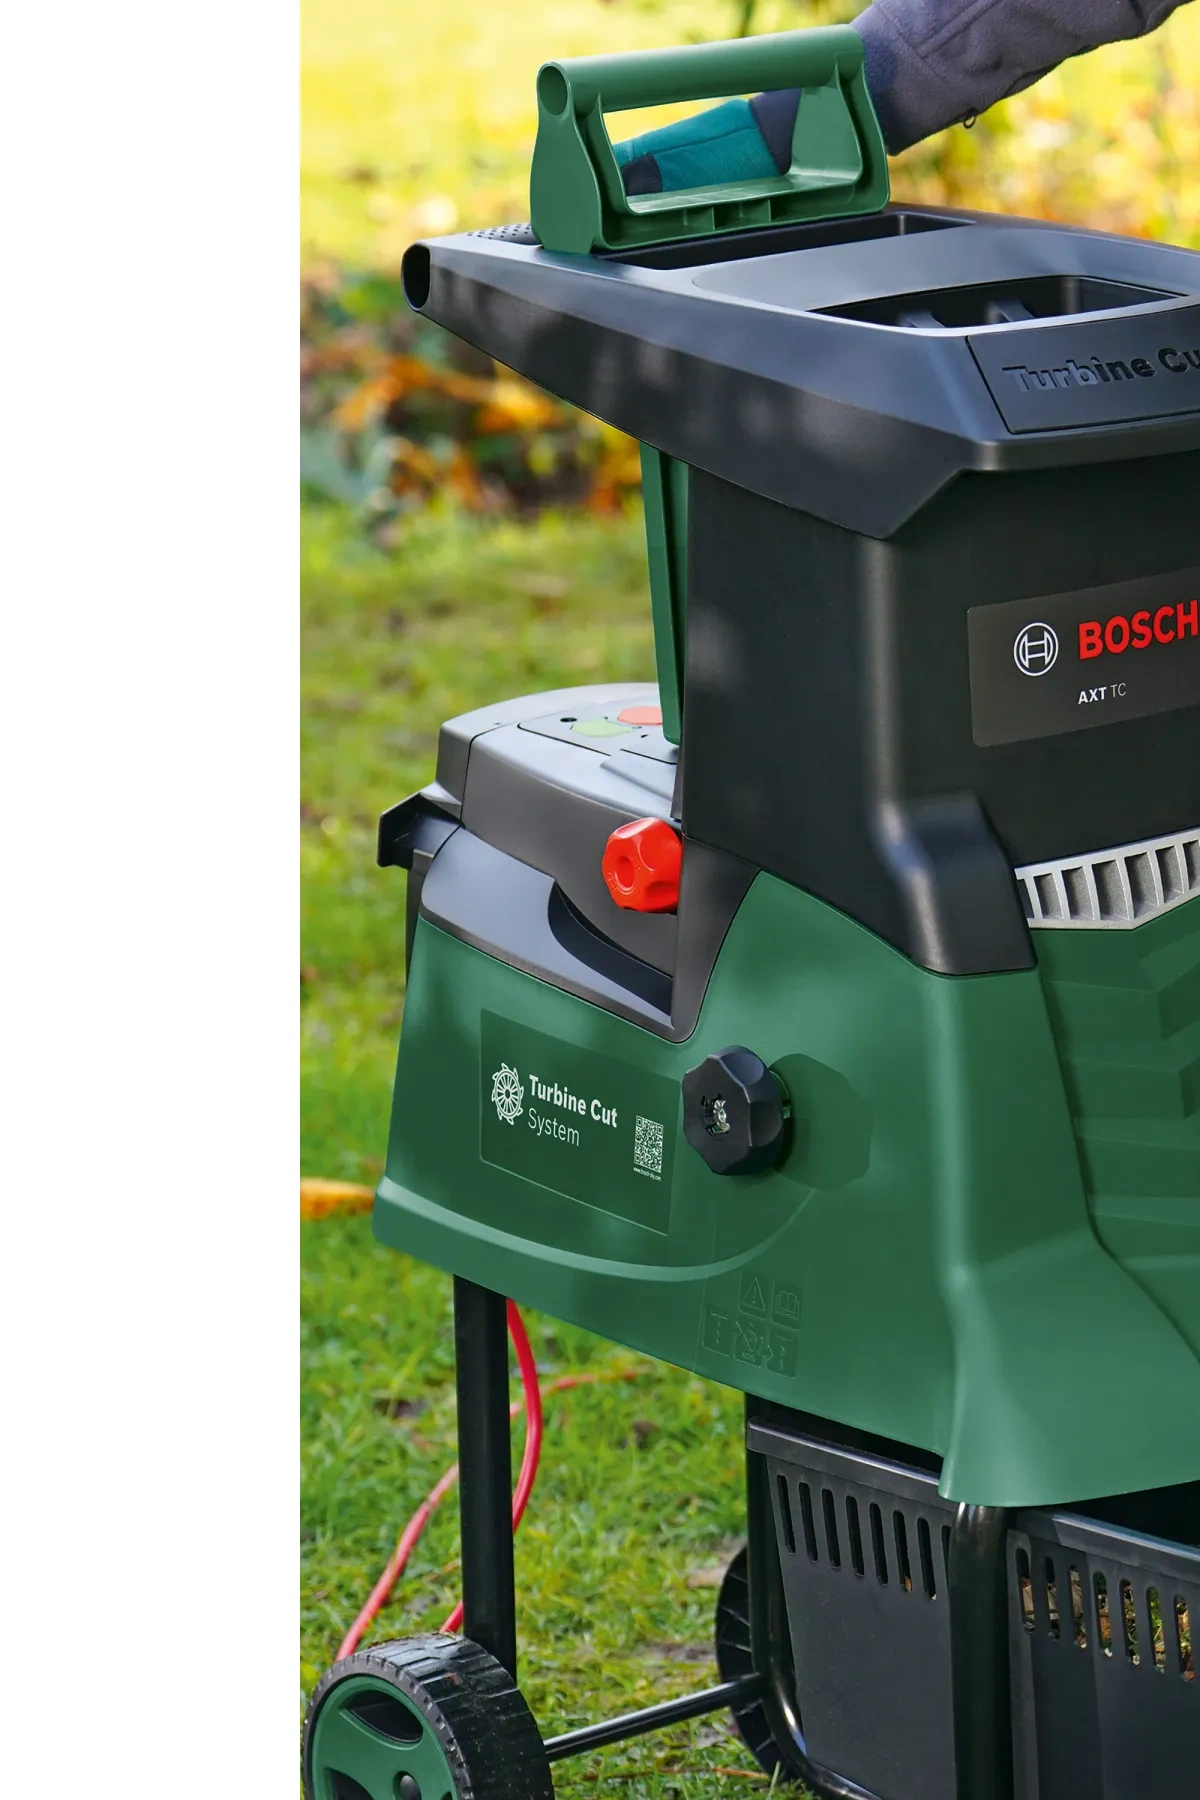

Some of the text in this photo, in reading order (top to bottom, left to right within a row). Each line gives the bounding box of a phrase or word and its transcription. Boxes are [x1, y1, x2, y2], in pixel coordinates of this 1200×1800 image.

[1002, 356, 1156, 393] Turbine
[1078, 599, 1199, 660] BOSCH
[1078, 682, 1127, 704] AXT TC
[529, 1074, 618, 1128] Turbine Cut
[528, 1107, 580, 1147] System
